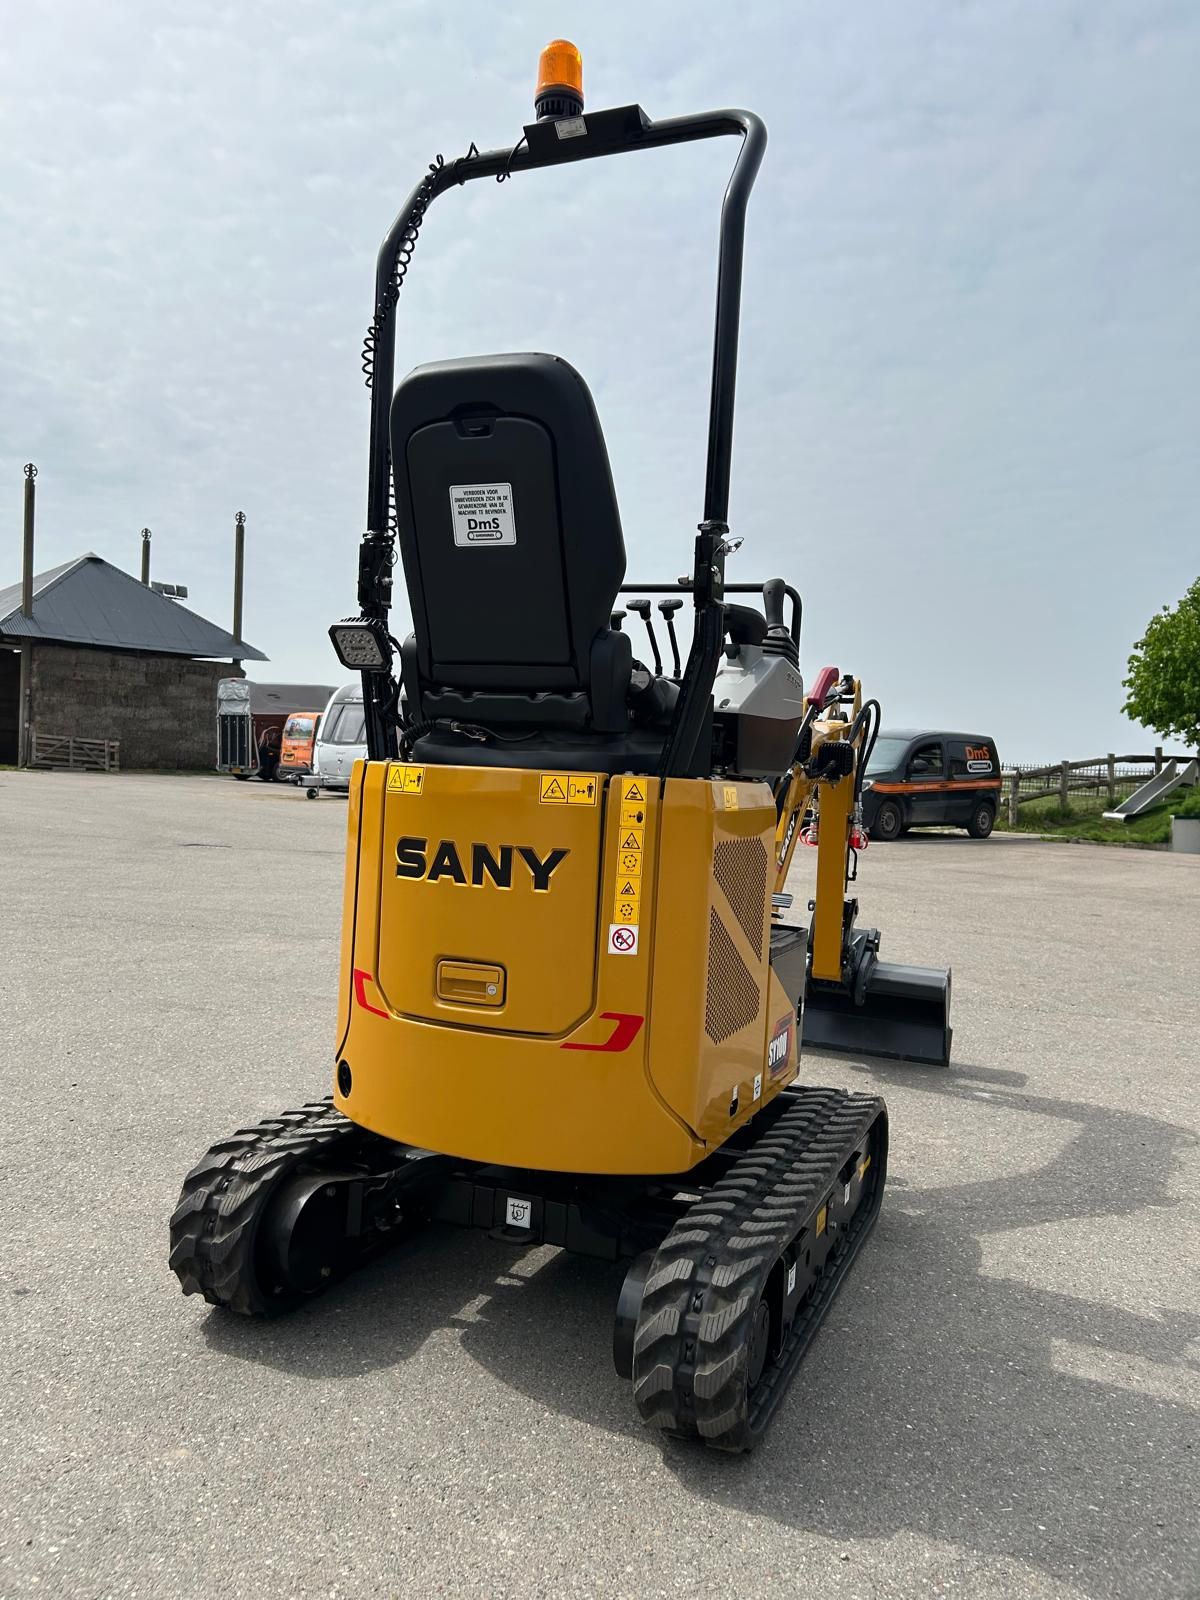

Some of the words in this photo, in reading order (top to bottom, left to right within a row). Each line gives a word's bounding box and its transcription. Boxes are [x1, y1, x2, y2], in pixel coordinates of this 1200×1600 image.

[467, 517, 500, 530] DmS
[965, 746, 990, 760] DmS
[395, 836, 571, 893] SANY
